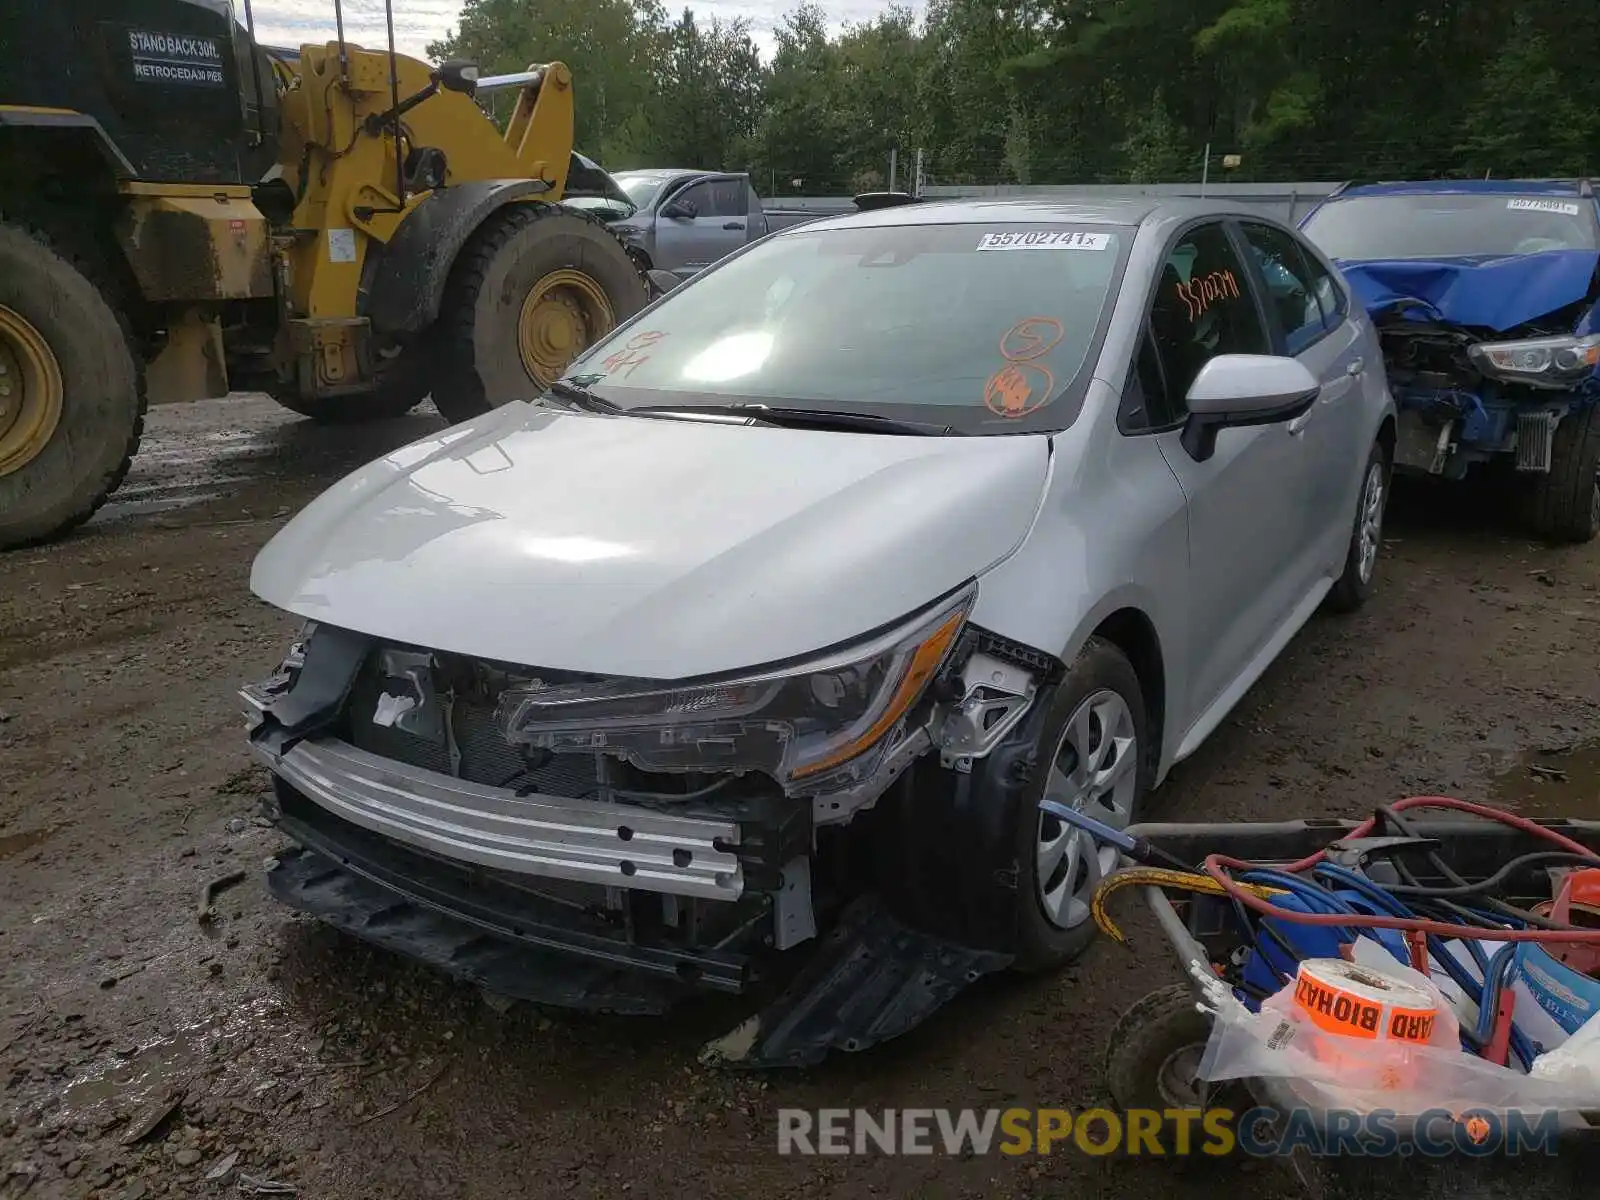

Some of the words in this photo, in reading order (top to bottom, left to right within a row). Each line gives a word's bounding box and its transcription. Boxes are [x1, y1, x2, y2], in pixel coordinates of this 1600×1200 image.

[129, 31, 166, 53] STAND
[167, 37, 198, 57] BACK
[134, 64, 198, 80] RETROCEDA
